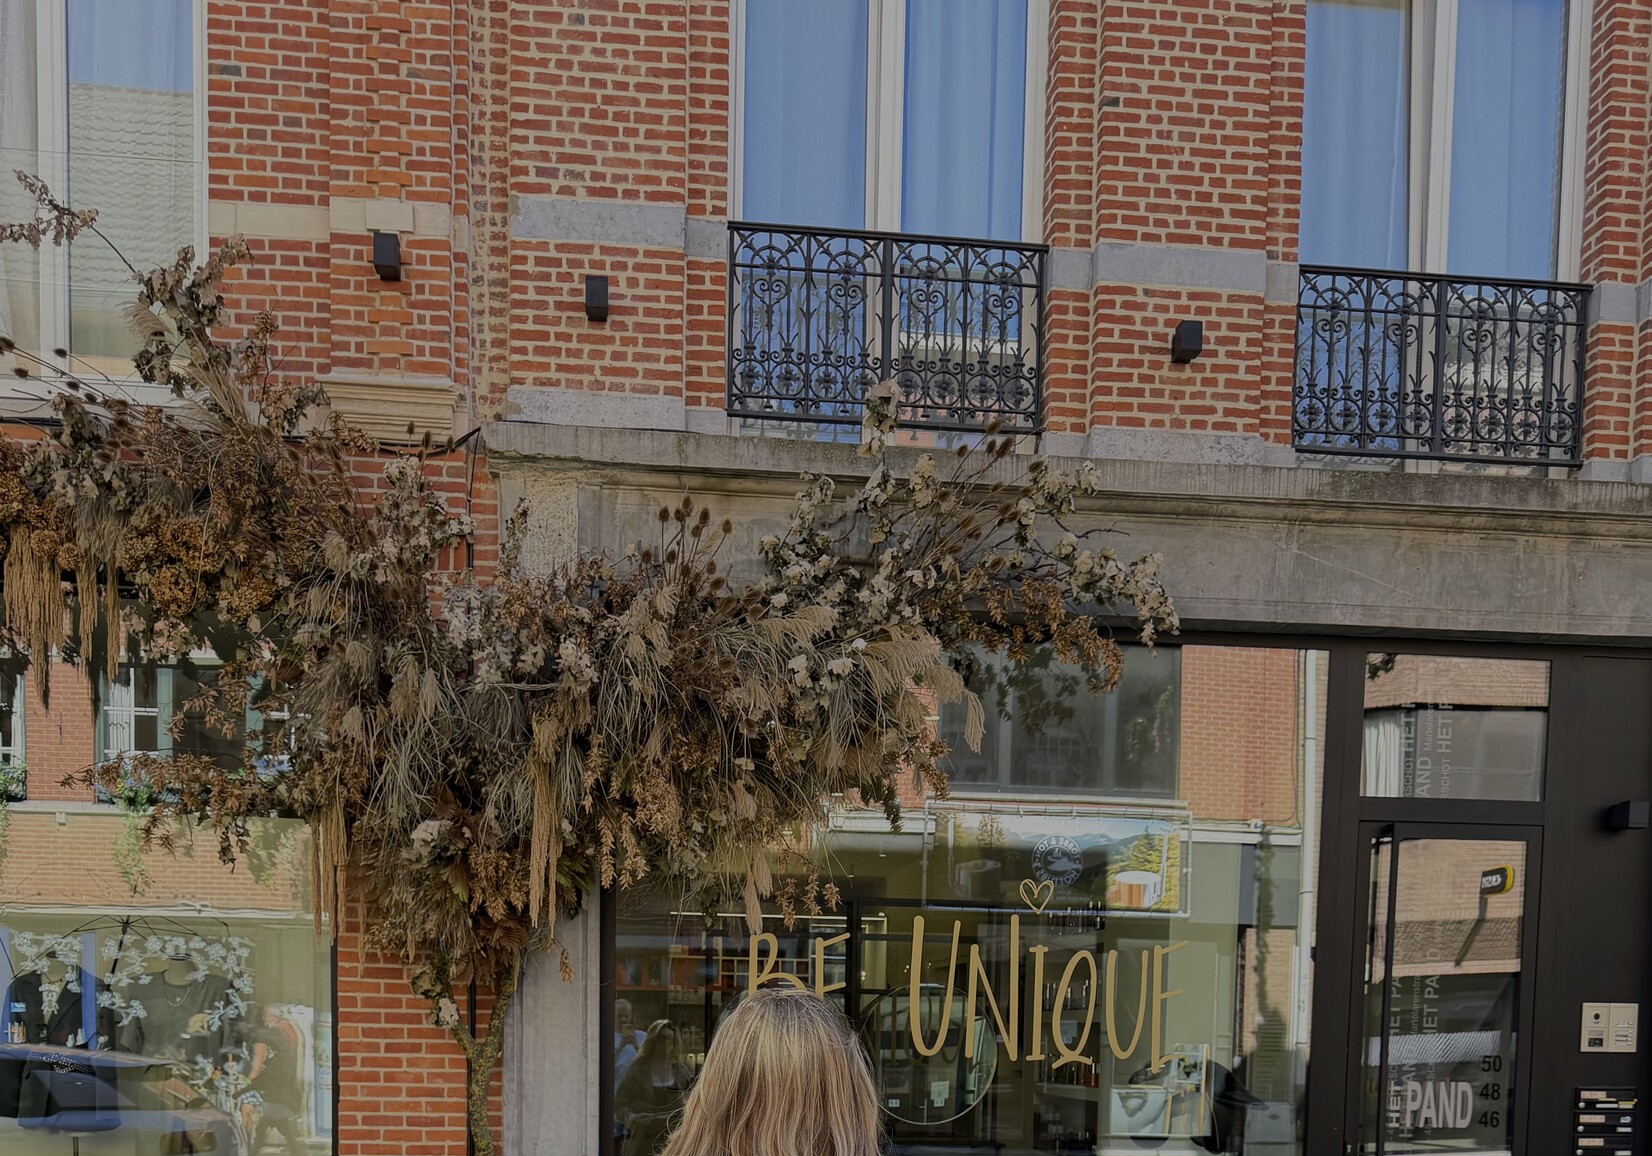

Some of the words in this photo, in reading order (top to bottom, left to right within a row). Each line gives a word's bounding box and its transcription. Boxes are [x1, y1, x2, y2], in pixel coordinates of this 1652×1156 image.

[1436, 715, 1453, 753] HET
[909, 914, 1189, 1073] UNIQUE
[1481, 1055, 1503, 1073] 50
[1386, 1081, 1402, 1128] HET
[1405, 1081, 1474, 1129] PAND
[1479, 1082, 1501, 1100] 48
[1478, 1110, 1500, 1128] 46
